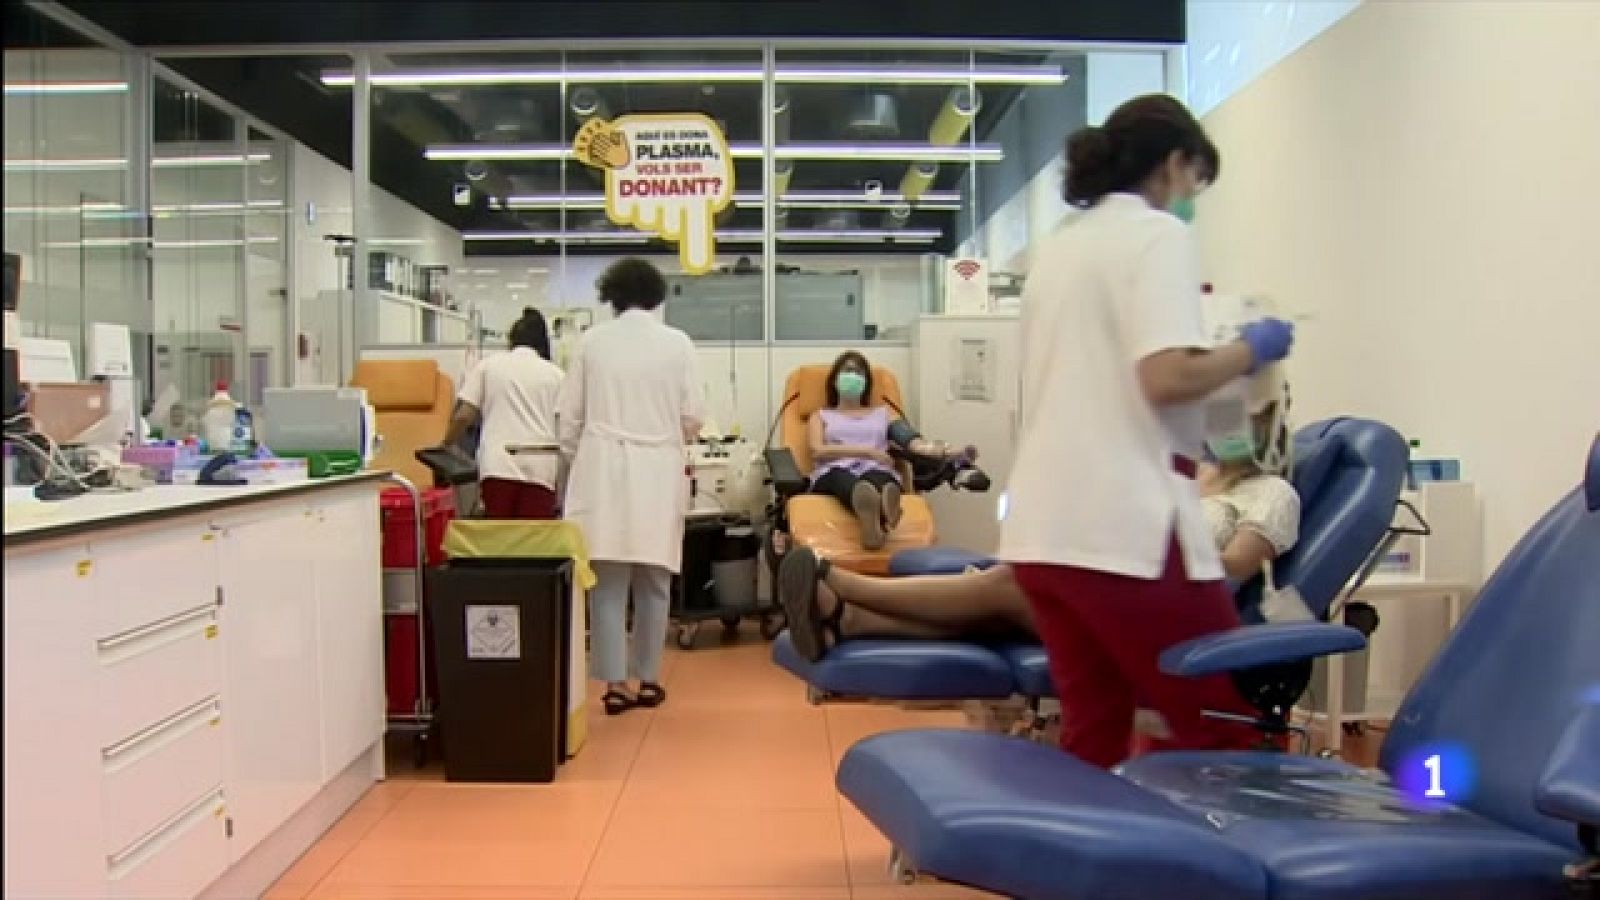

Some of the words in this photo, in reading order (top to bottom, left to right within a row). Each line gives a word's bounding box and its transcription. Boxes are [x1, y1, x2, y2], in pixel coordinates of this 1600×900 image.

[636, 143, 720, 161] PLASMA,
[674, 162, 704, 174] SER
[619, 178, 723, 196] DONANT?
